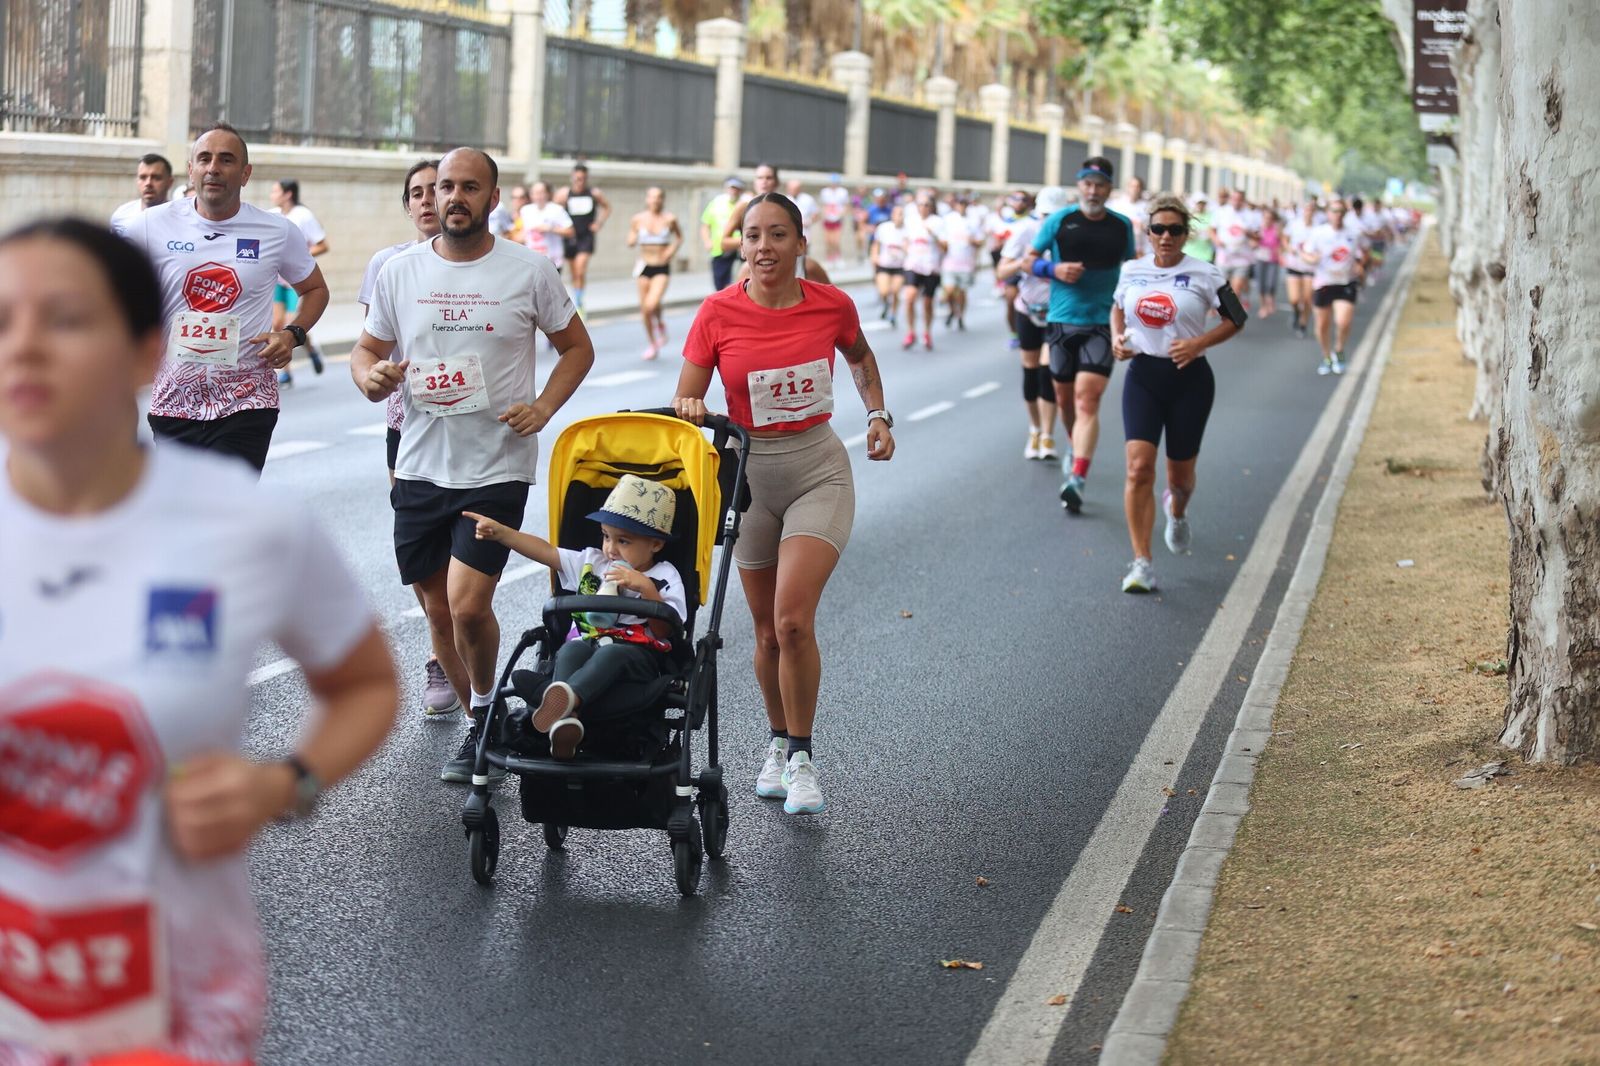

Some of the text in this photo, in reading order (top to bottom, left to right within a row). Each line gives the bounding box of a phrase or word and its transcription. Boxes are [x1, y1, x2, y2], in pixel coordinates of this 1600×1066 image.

[236, 248, 256, 258] AXA
[190, 286, 229, 305] FRENO
[193, 275, 235, 297] PONLE
[466, 292, 482, 300] regalo
[181, 324, 228, 341] 1241
[425, 370, 466, 391] 324
[769, 378, 815, 398] 712
[0, 931, 132, 988] 347
